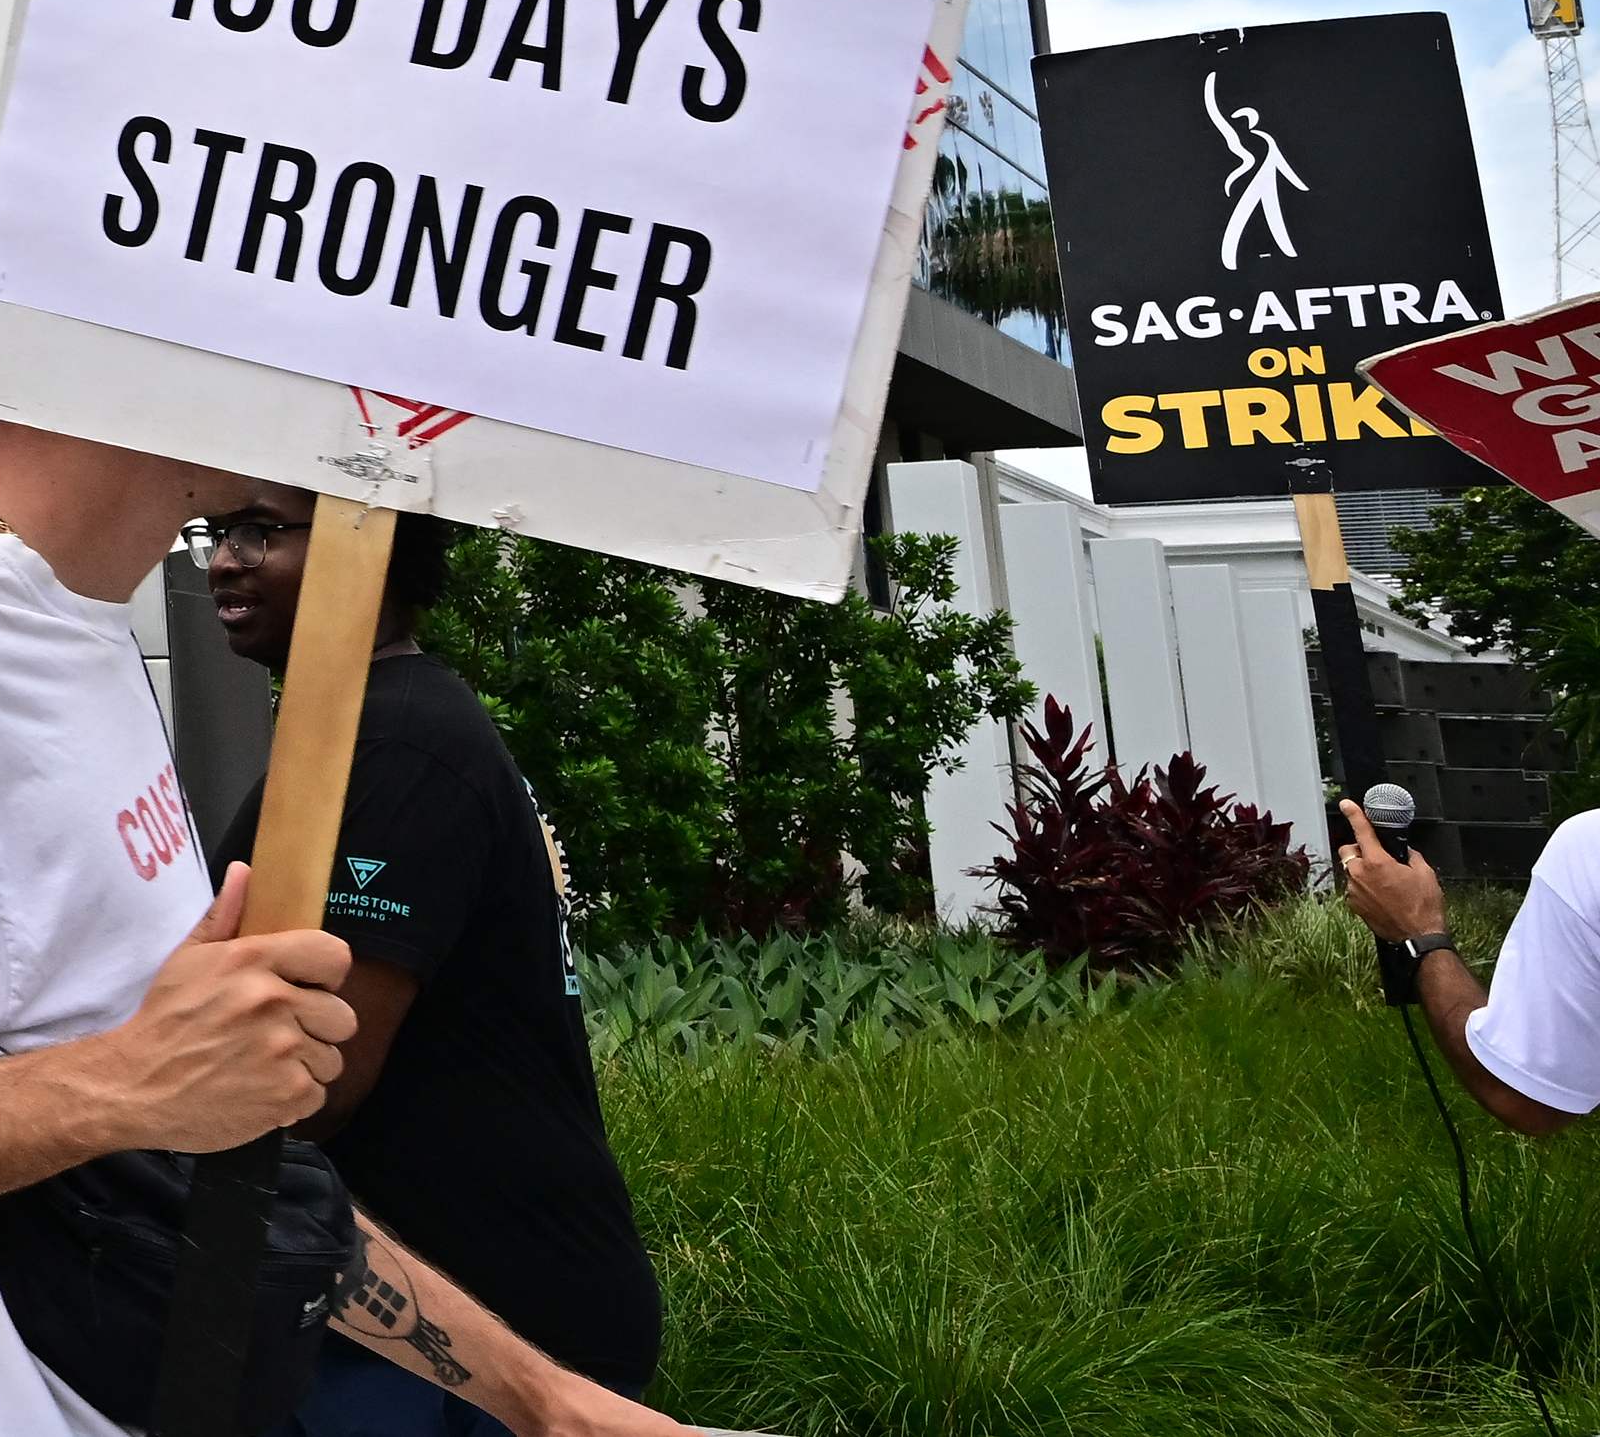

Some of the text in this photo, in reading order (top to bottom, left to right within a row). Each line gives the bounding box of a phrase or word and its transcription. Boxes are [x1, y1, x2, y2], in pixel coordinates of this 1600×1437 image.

[102, 115, 713, 371] STRONGER
[1247, 345, 1326, 378] ON
[1100, 380, 1441, 455] STRIK
[324, 891, 412, 918] UCHSTONE
